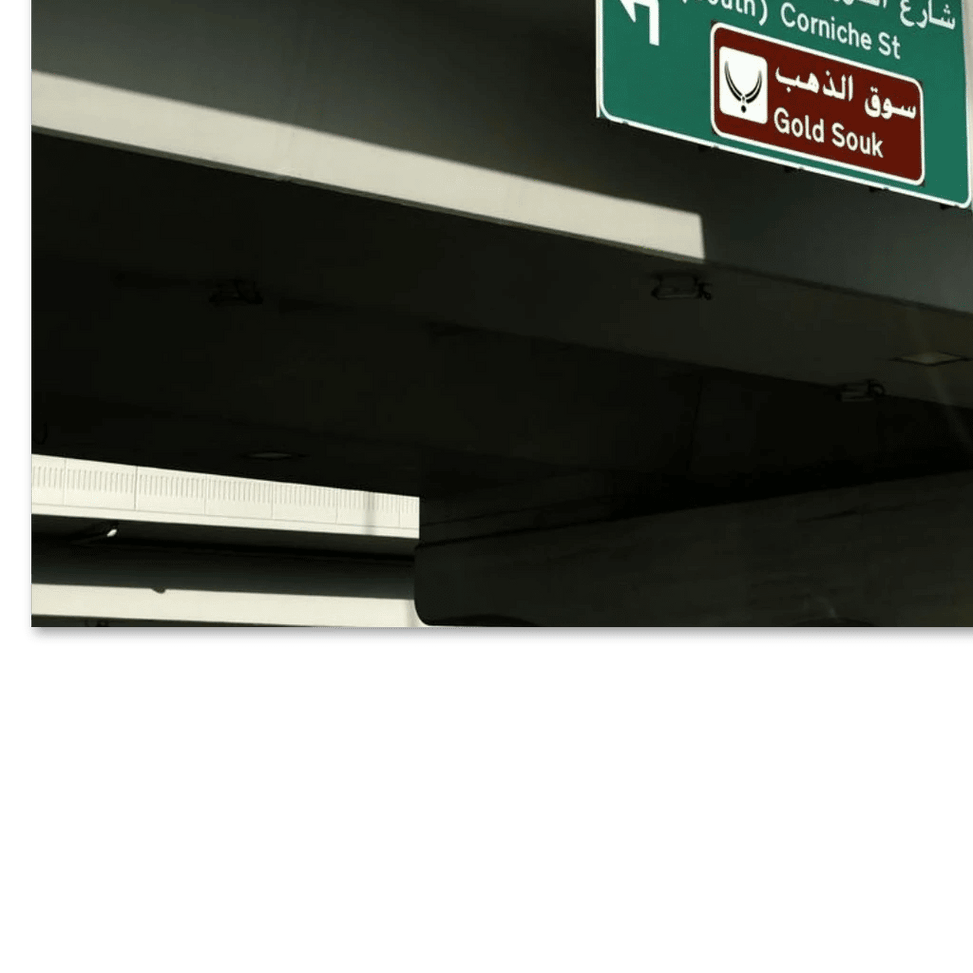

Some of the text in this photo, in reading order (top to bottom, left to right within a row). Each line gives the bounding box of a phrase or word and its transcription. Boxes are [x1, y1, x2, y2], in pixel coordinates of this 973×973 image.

[780, 2, 872, 51] Corniche
[877, 32, 901, 60] St
[774, 66, 917, 120] سوق الذهب
[773, 107, 884, 158] Gold Souk
